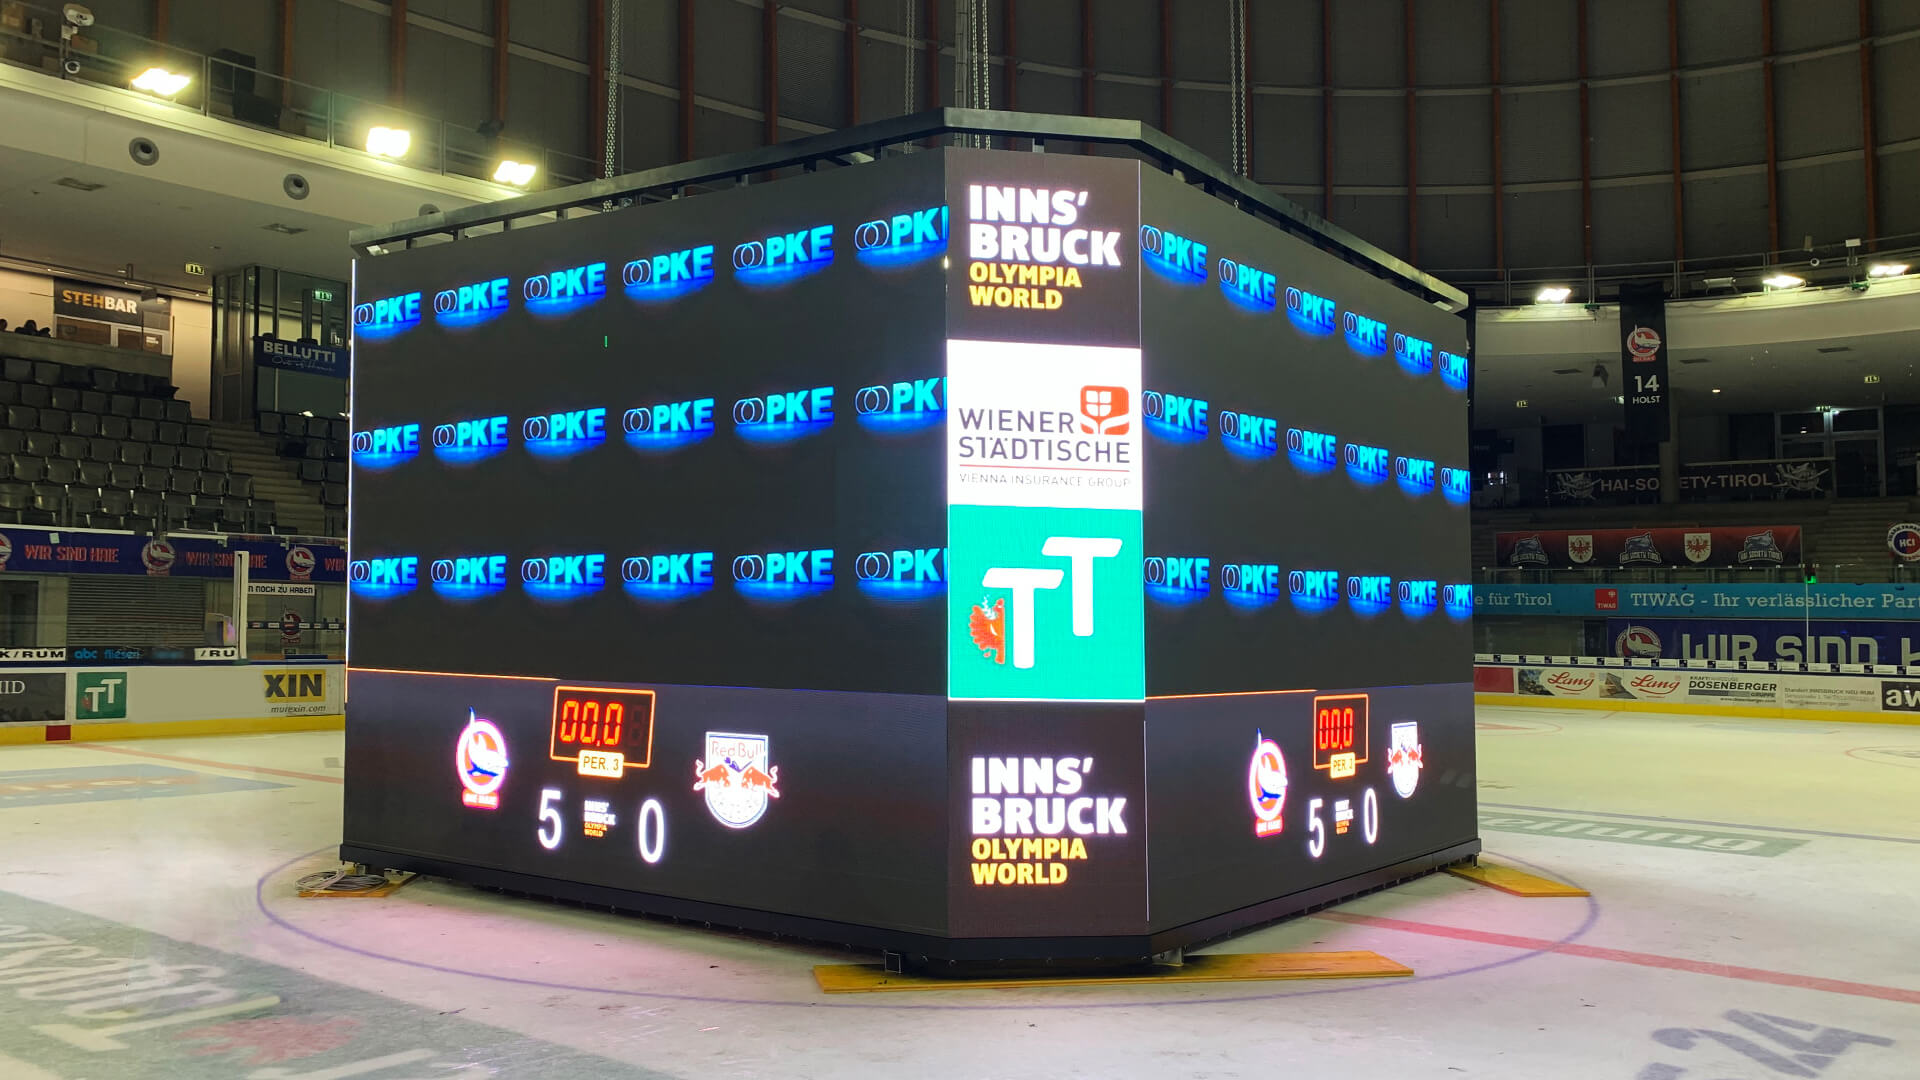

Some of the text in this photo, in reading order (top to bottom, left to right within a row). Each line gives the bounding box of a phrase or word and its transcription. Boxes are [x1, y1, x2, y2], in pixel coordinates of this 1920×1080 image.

[969, 185, 1088, 225] INNS'
[767, 225, 833, 266] PKE
[969, 223, 1121, 266] BRUCK
[1164, 232, 1207, 275] PKE
[653, 246, 713, 284] PKE
[969, 261, 1082, 287] OLYMPIA
[459, 278, 508, 311] PKE
[551, 263, 605, 298] PKE
[1238, 264, 1276, 305] PKE
[62, 290, 137, 313] STEHBAR
[375, 292, 420, 324] PKE
[969, 285, 1063, 310] WORLD
[1302, 292, 1336, 328] PKE
[1358, 316, 1387, 350] PKE
[263, 340, 336, 363] BELLUTTI
[1407, 337, 1433, 367] PKE
[1634, 374, 1660, 393] 14
[767, 387, 833, 425] PKE
[1165, 394, 1208, 434] PKE
[1632, 395, 1661, 405] HOLST
[551, 408, 605, 441] PKE
[653, 399, 713, 432] PKE
[958, 408, 1074, 433] WIENER
[373, 424, 419, 454] PKE
[457, 416, 507, 447] PKE
[1239, 414, 1277, 450] PKE
[959, 436, 1130, 464] STÄDTISCHE
[1303, 431, 1336, 463] PKE
[1359, 447, 1389, 475] PKE
[960, 473, 1130, 488] VIENNA INSURANCE GROUP
[1408, 459, 1435, 485] PKE
[24, 544, 52, 560] WIR
[1899, 538, 1916, 549] HCI
[372, 557, 417, 584] PKE
[456, 556, 506, 584] PKE
[550, 555, 604, 584] PKE
[652, 553, 713, 584] PKE
[767, 550, 833, 584] PKE
[1166, 558, 1209, 591] PKE
[1241, 565, 1279, 596] PKE
[1305, 571, 1338, 600] PKE
[1362, 576, 1391, 602] PKE
[1411, 581, 1437, 605] PKE
[1488, 592, 1510, 606] für
[1514, 592, 1553, 606] Tirol
[1630, 592, 1695, 607] TIWAG
[1713, 592, 1740, 607] Ihr
[1748, 592, 1875, 608] verlässlicher
[264, 673, 322, 698] XIN
[1547, 671, 1595, 692] Lang
[1631, 674, 1680, 695] Lang
[1689, 680, 1777, 692] DOSENBERGER
[613, 758, 619, 771] 3
[972, 757, 1093, 795] INNS'
[538, 788, 562, 850] 5
[972, 797, 1127, 835] BRUCK
[1309, 798, 1325, 858] 5
[1364, 787, 1378, 844] 0
[638, 799, 664, 863] 0
[972, 838, 1088, 860] OLYMPIA
[971, 863, 1068, 884] WORLD
